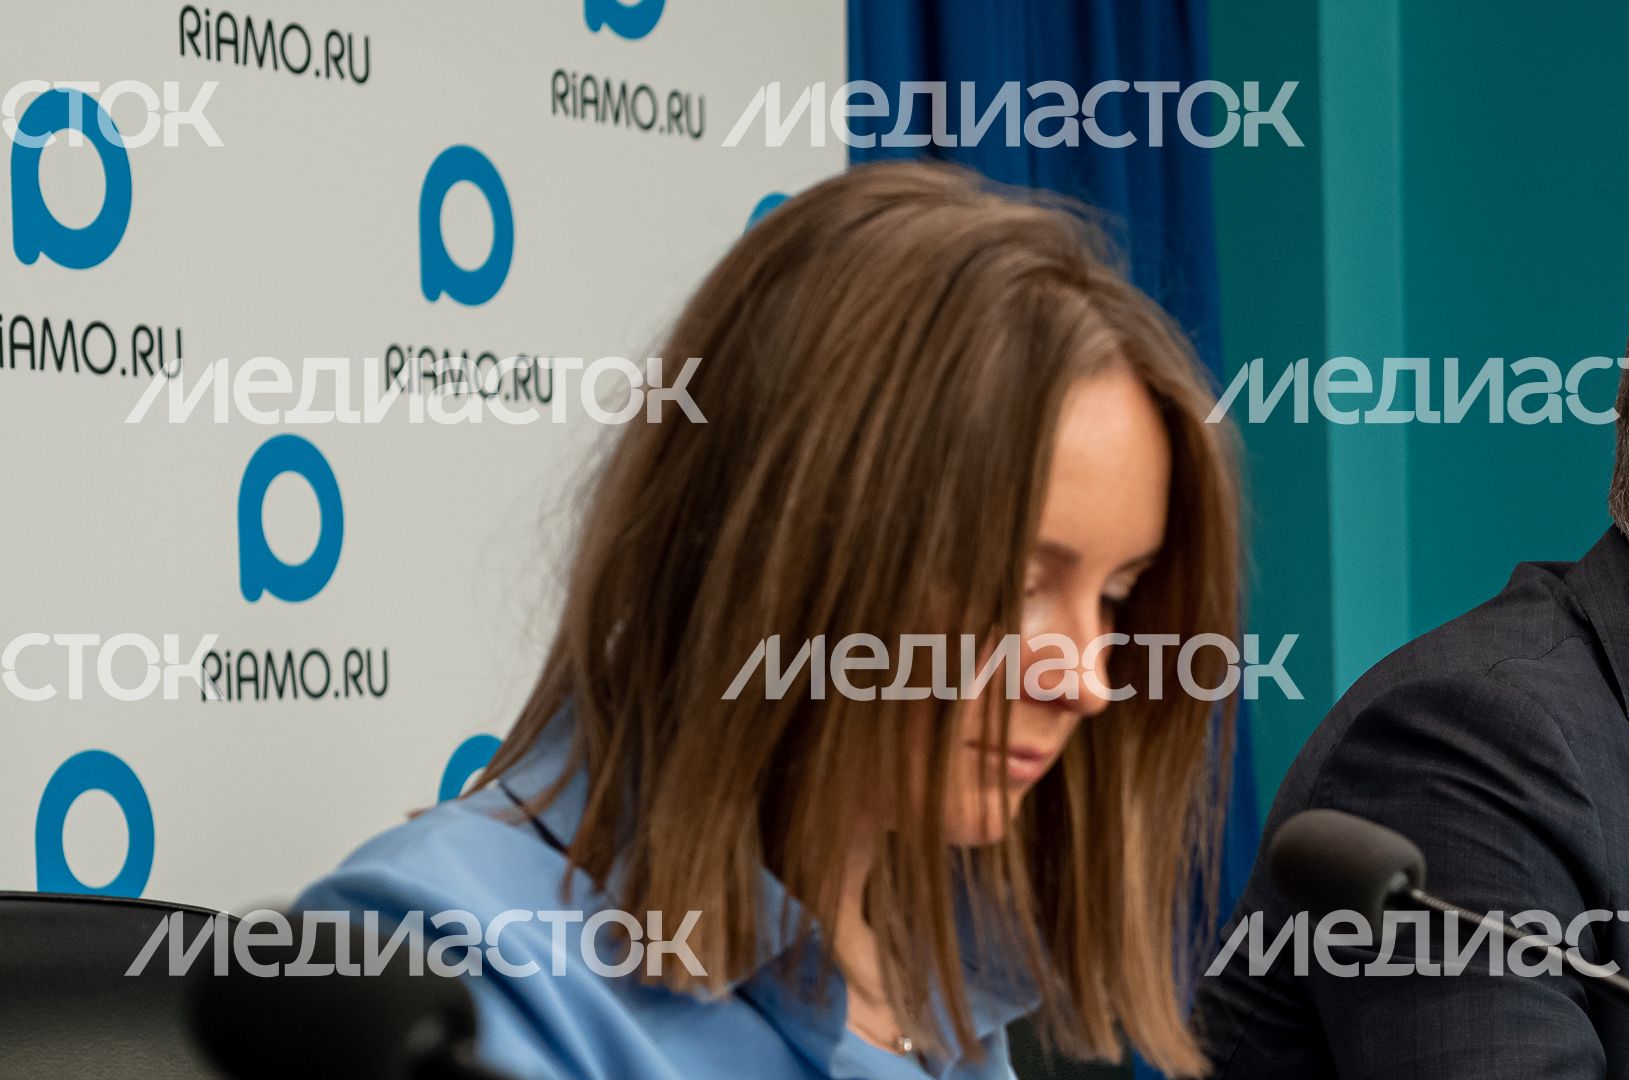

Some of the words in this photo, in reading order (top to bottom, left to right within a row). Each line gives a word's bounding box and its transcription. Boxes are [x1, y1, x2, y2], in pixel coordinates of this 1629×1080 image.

[178, 5, 371, 85] RiAMO.RU
[551, 68, 704, 140] RiAMO.RU
[200, 648, 389, 702] RiAMO.RU
